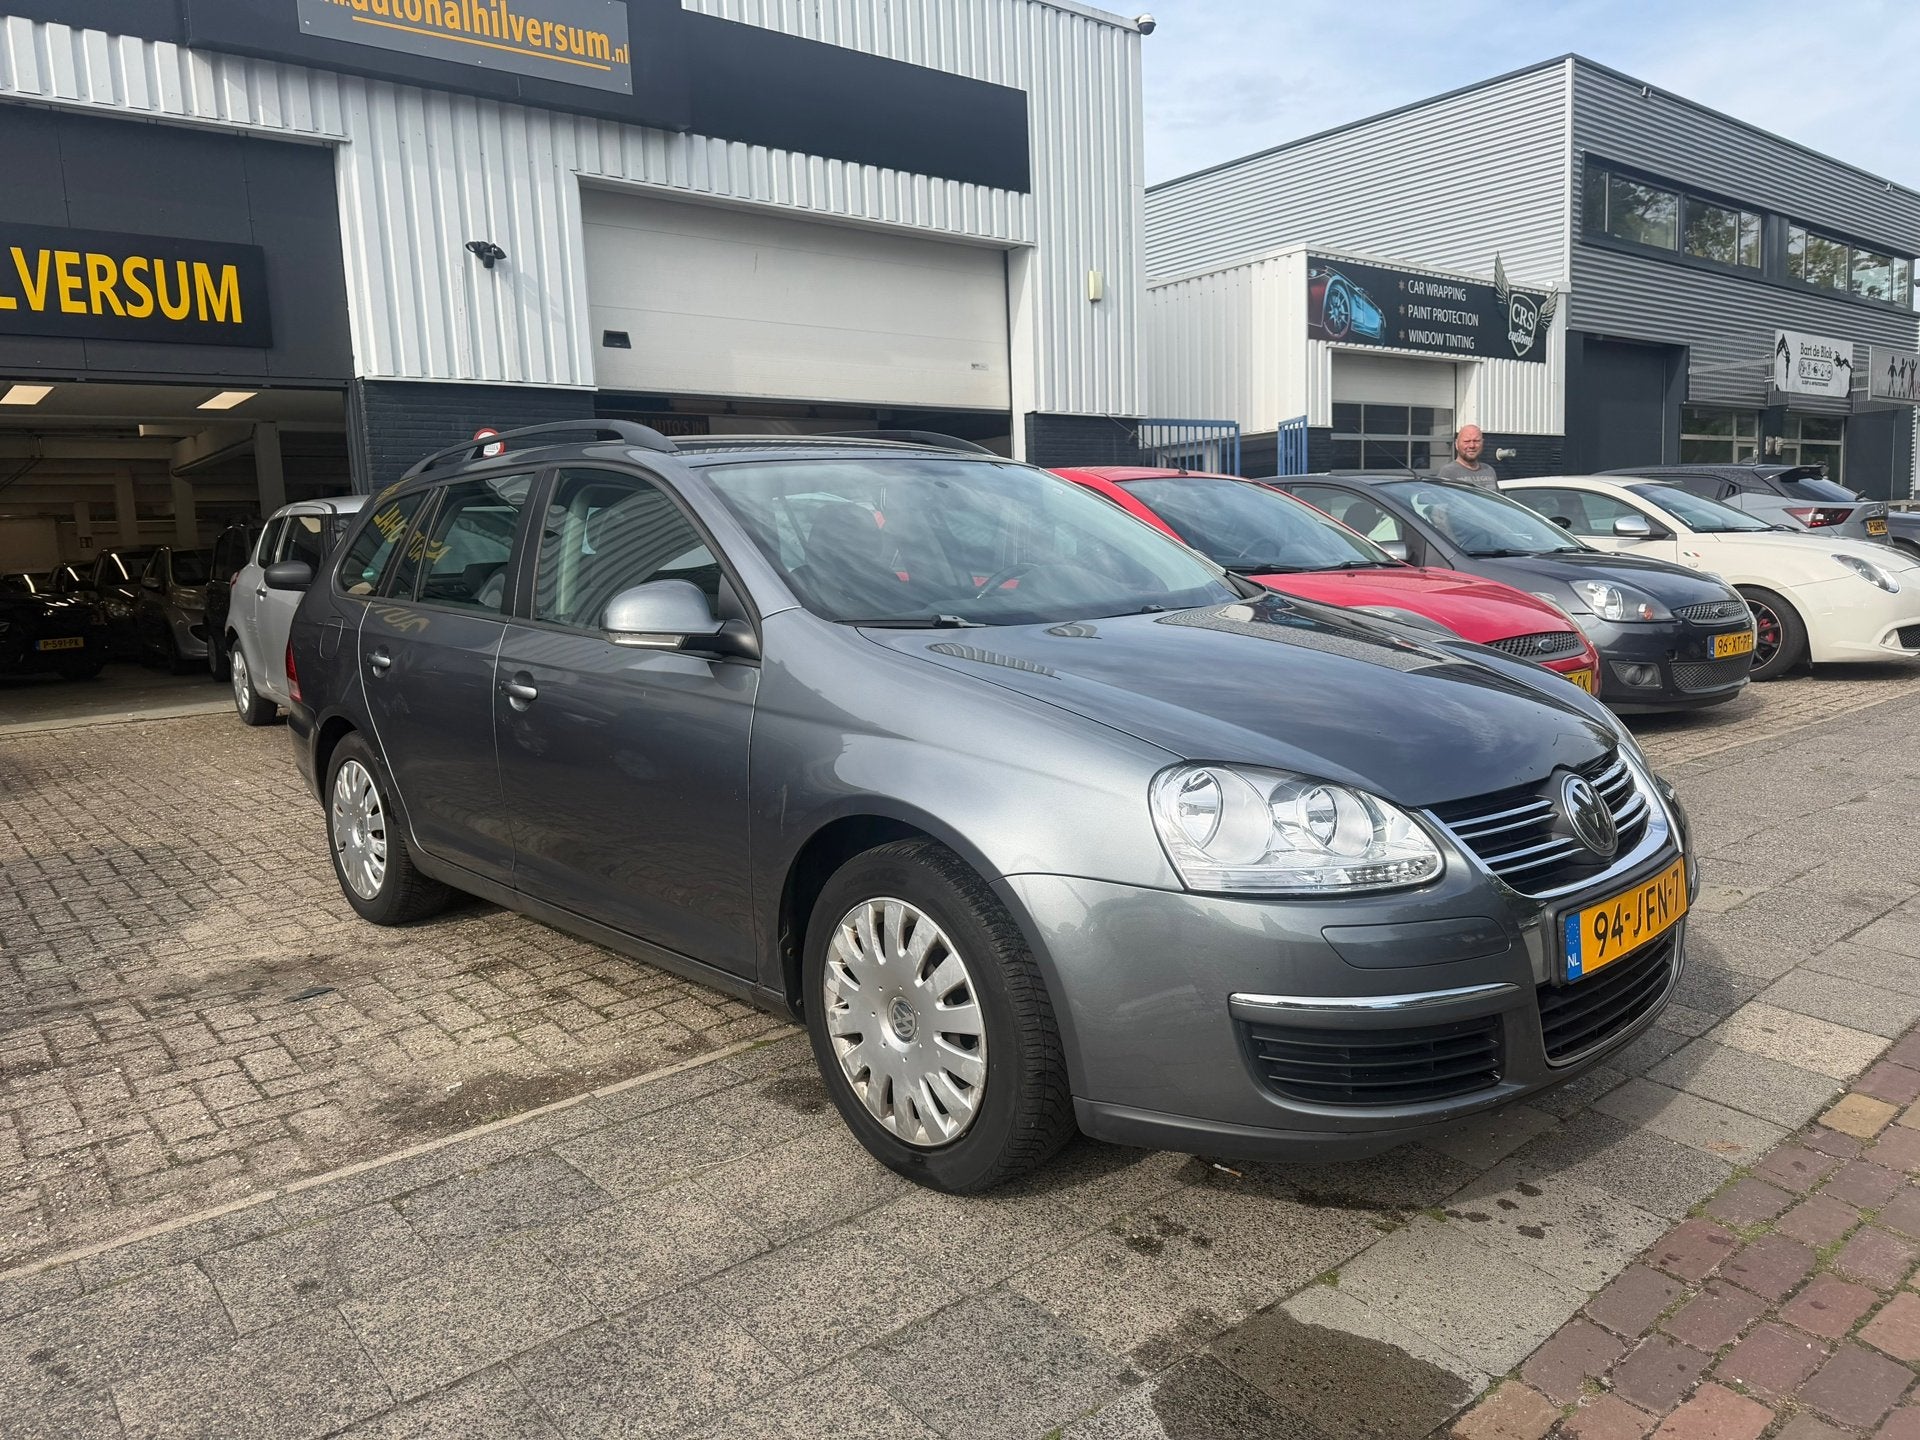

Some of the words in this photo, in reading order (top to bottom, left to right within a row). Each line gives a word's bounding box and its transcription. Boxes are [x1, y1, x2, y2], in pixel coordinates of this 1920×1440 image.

[0, 246, 243, 324] VERSUM
[1408, 280, 1425, 295] CAR
[1425, 283, 1466, 301] WRAPPING
[1408, 304, 1432, 320] PAINT
[1432, 308, 1479, 326] PROTECTION
[1512, 303, 1534, 331] CRS
[1408, 329, 1444, 346] WINDOW
[1445, 333, 1475, 350] TINTING
[1593, 868, 1679, 958] 94-JFN-7
[1567, 952, 1580, 968] NL
